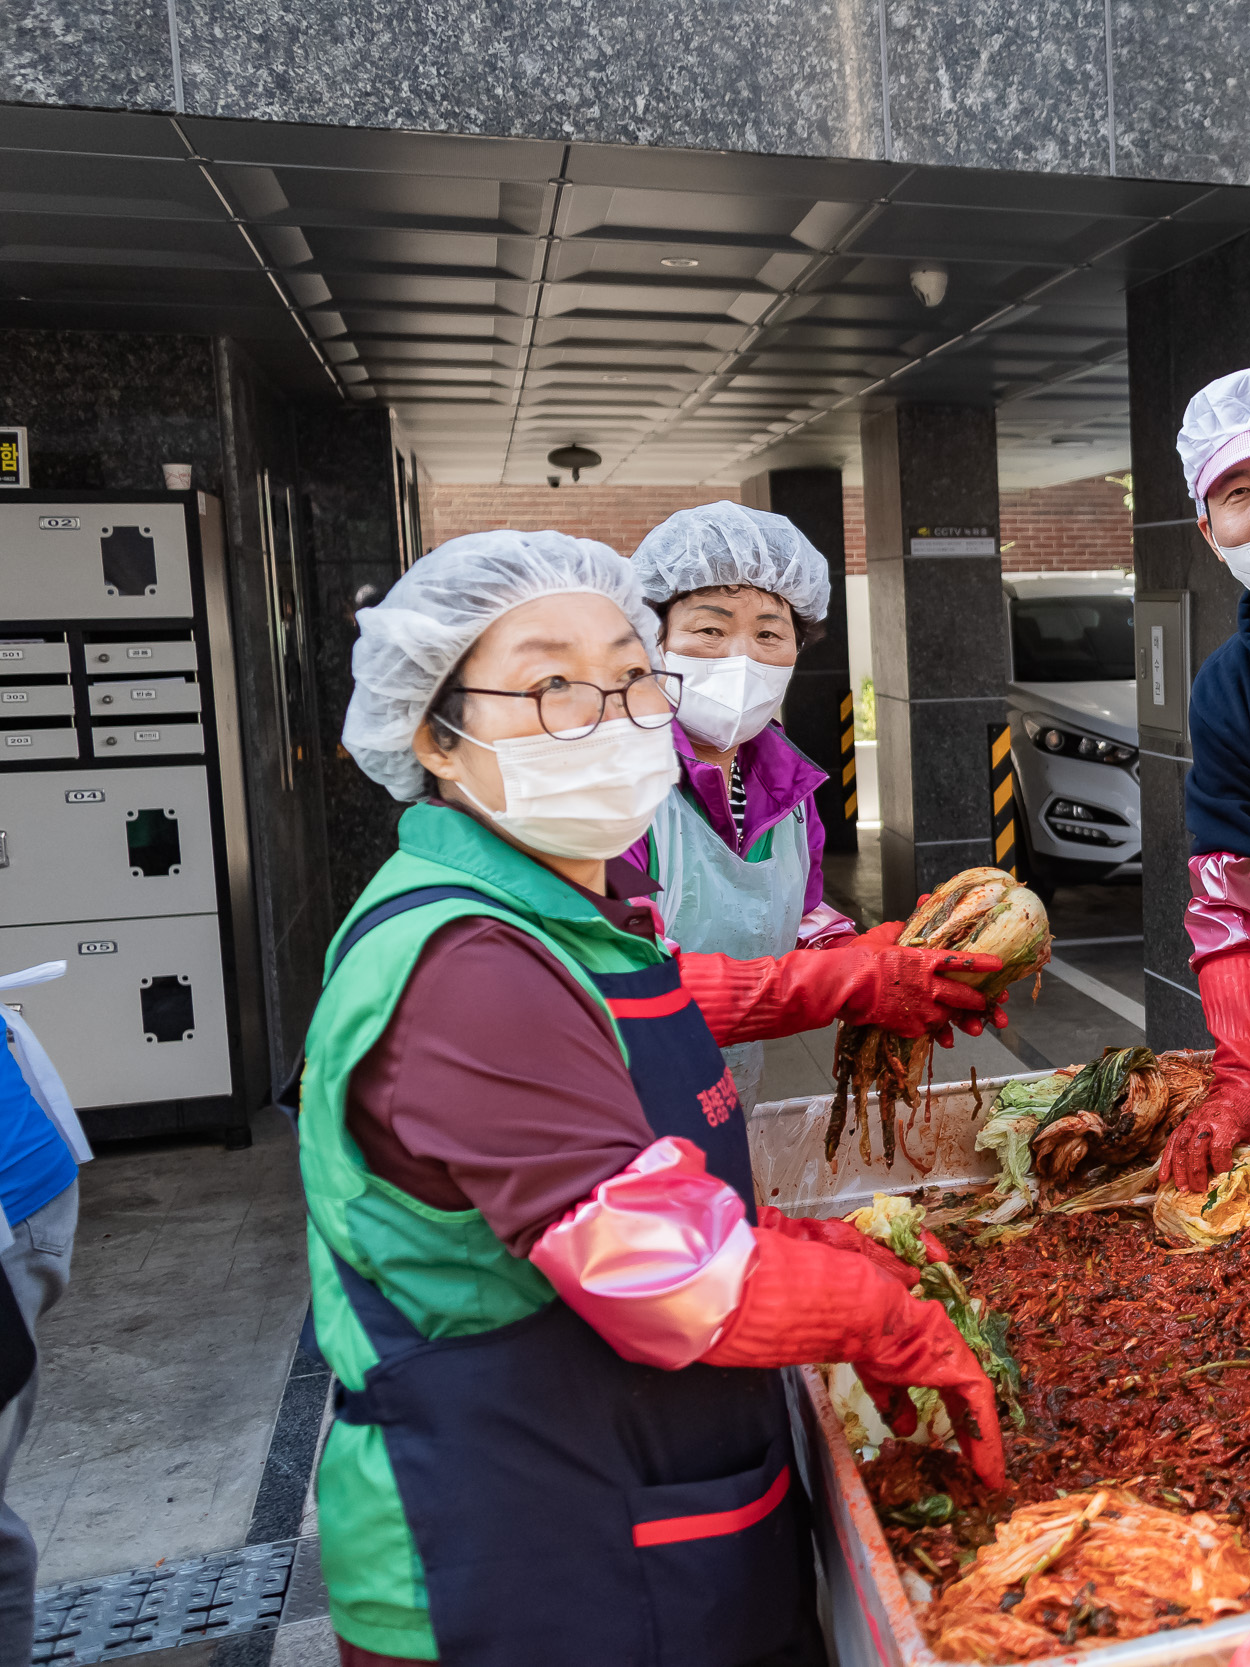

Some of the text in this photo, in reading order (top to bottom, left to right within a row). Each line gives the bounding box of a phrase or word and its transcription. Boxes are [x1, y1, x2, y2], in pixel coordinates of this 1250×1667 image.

[47, 518, 73, 529] 02
[934, 526, 961, 537] CCTV
[73, 791, 98, 801] 04
[86, 943, 111, 952] 05
